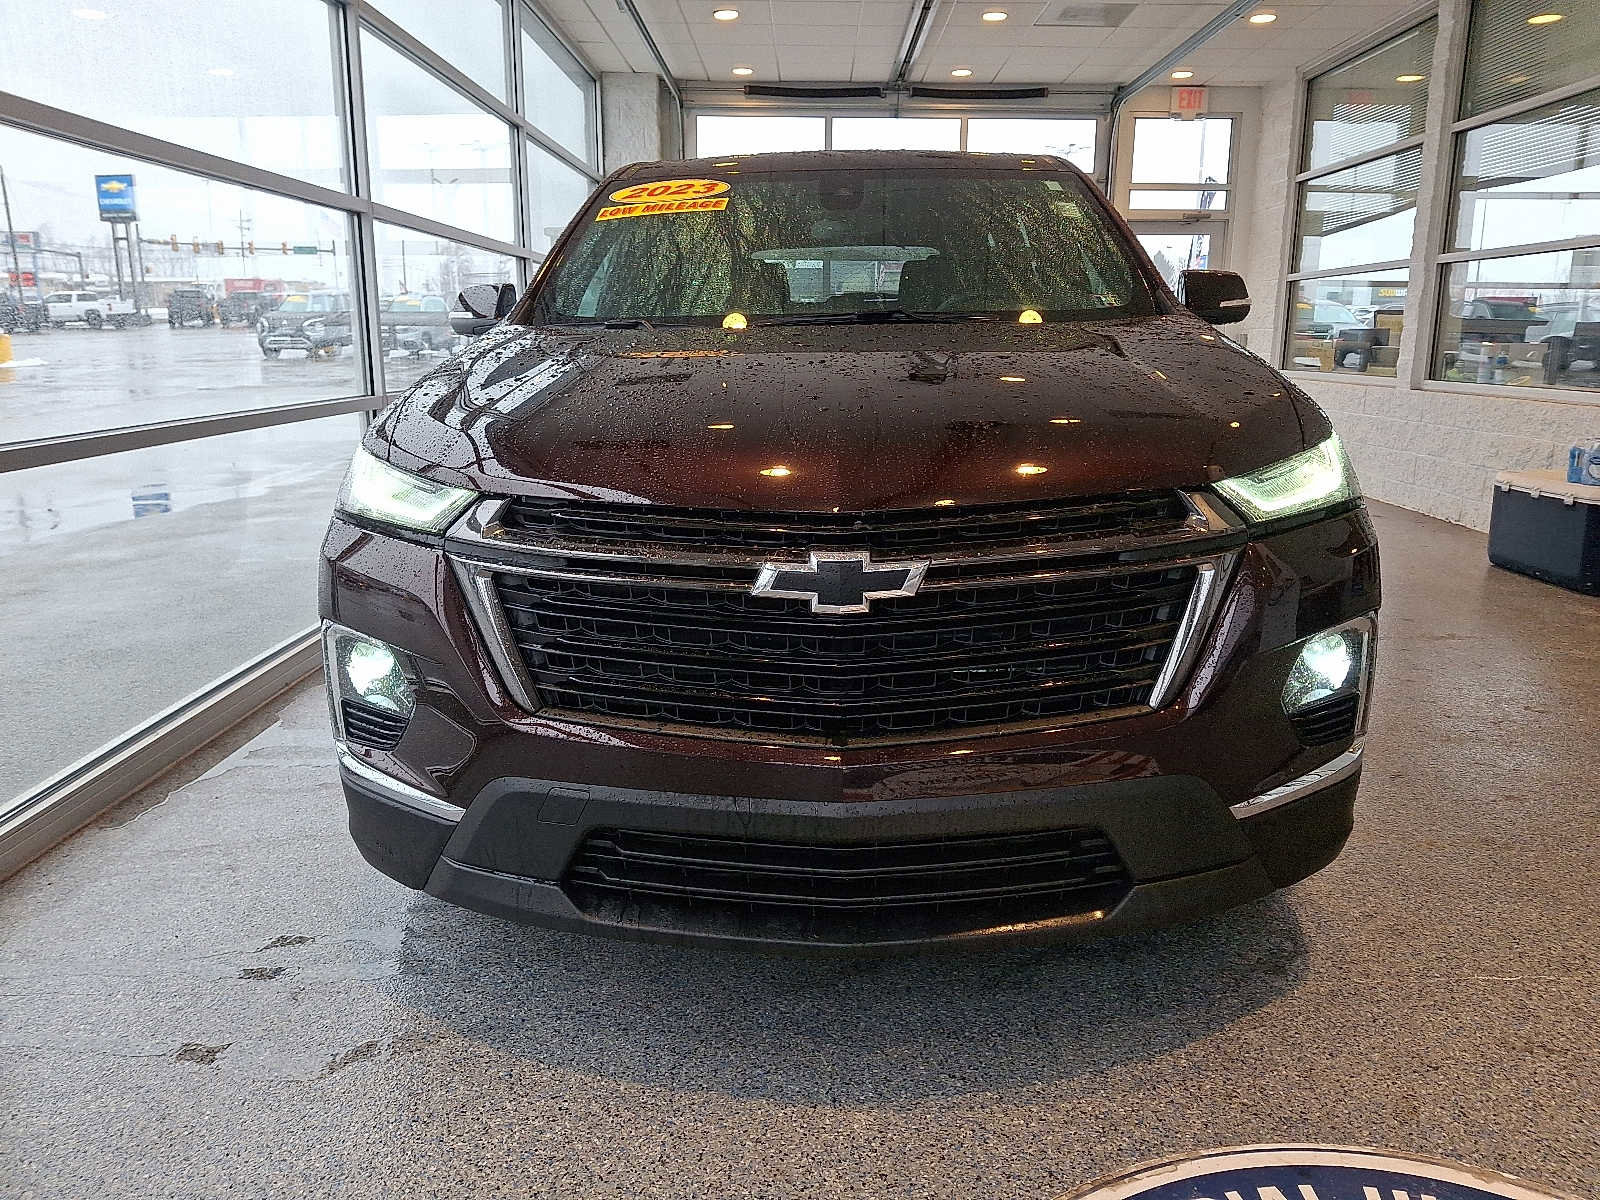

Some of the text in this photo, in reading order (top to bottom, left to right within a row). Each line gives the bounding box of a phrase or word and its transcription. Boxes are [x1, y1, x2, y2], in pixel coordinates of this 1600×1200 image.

[1178, 88, 1205, 109] EXIT
[619, 182, 720, 200] 2023
[598, 199, 724, 219] LOW MILEAGE
